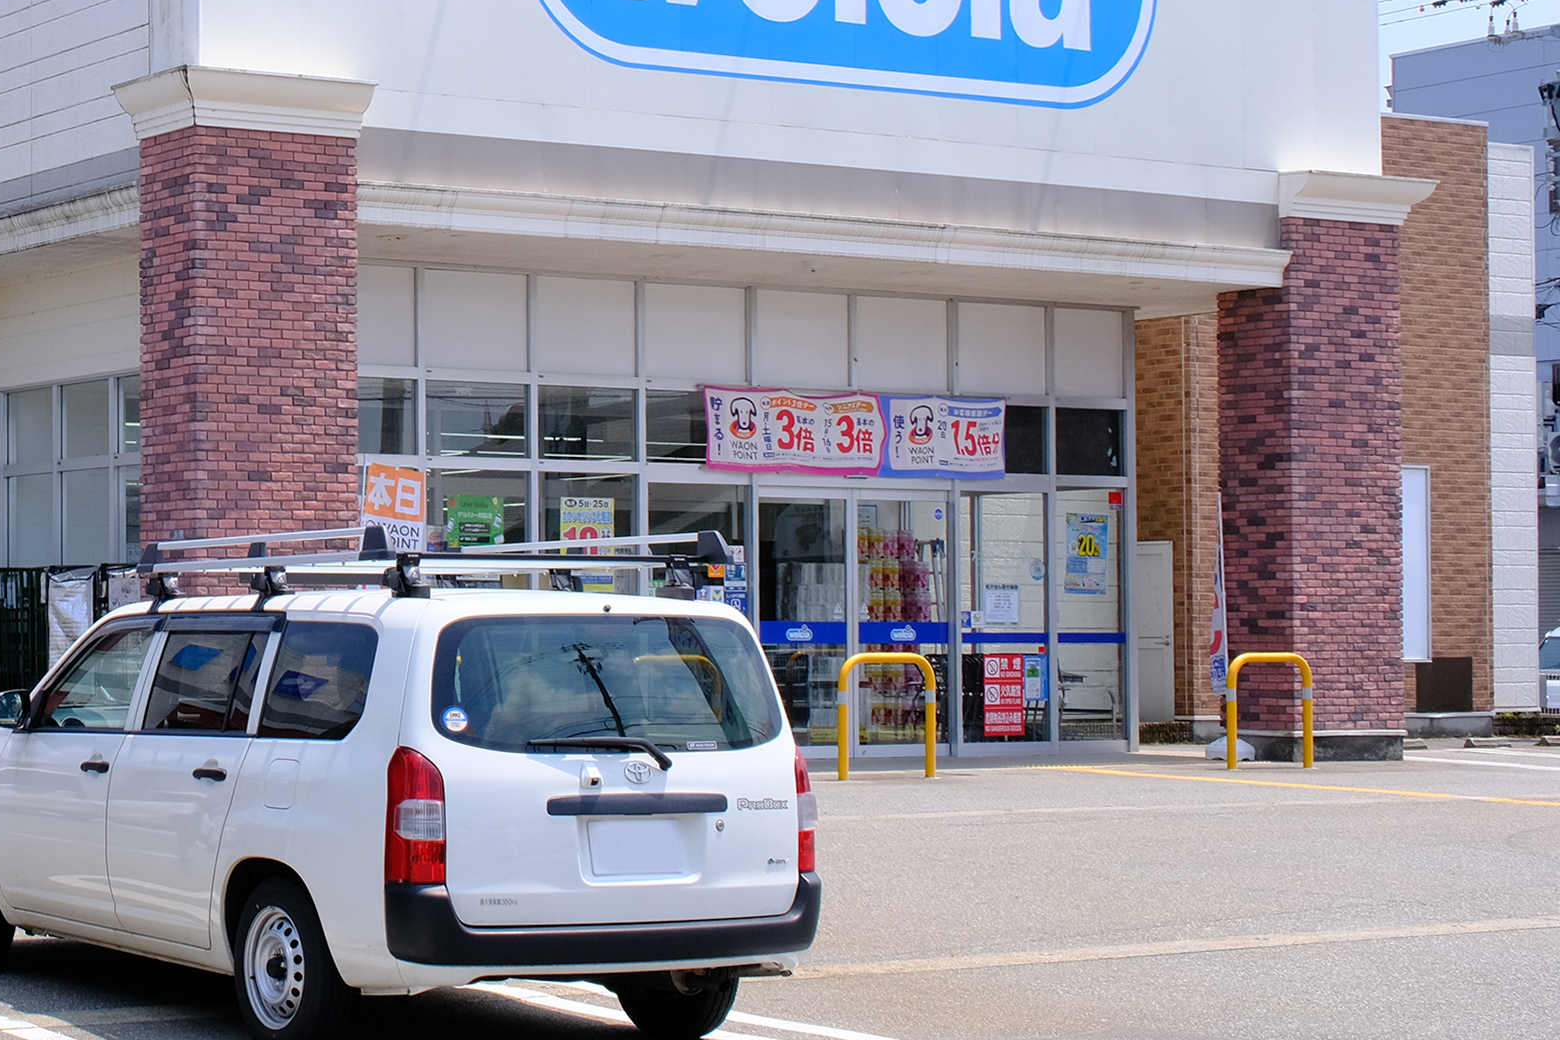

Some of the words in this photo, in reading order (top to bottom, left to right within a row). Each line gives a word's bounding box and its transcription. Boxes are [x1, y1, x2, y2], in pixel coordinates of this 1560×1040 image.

[730, 440, 758, 451] WAON
[907, 446, 935, 455] WAON
[732, 449, 758, 460] POINT
[910, 455, 935, 465] POINT
[367, 472, 422, 516] 本日
